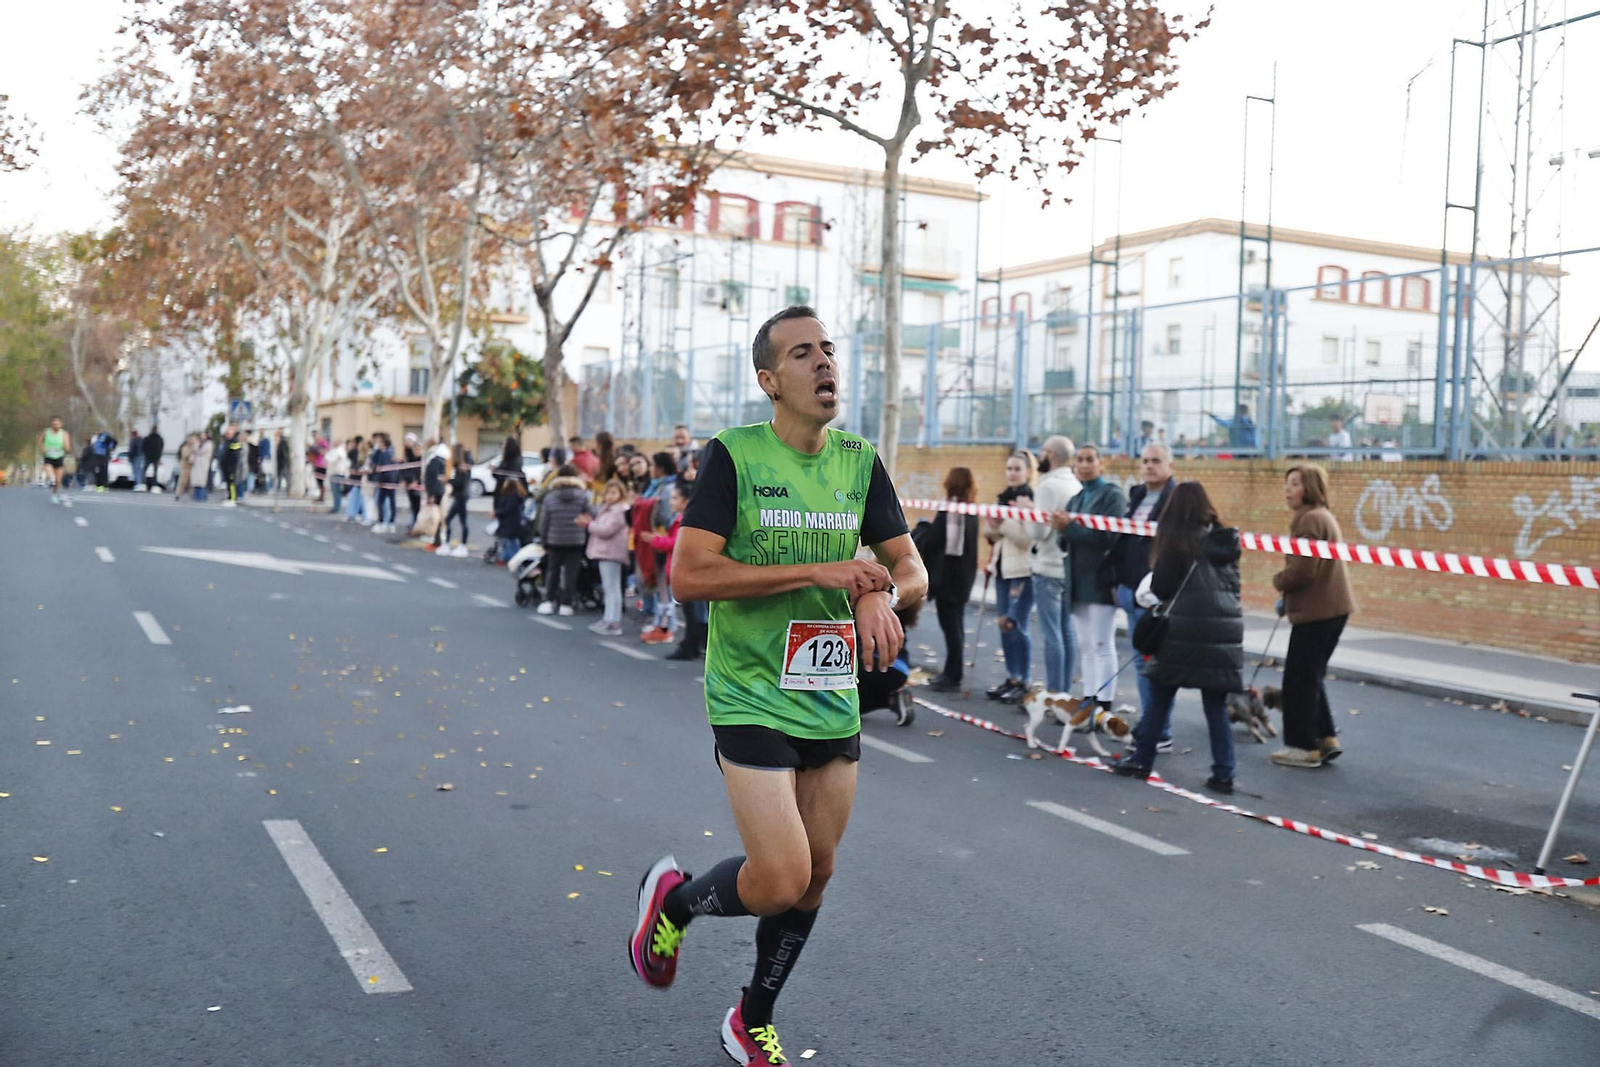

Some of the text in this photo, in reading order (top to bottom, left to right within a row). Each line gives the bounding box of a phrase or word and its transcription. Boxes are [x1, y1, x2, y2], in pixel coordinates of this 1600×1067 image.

[841, 439, 862, 450] 2023
[753, 485, 789, 498] HOKA
[846, 491, 863, 503] edp
[760, 508, 859, 530] MEDIO MARATÓN
[761, 929, 805, 990] kalenji
